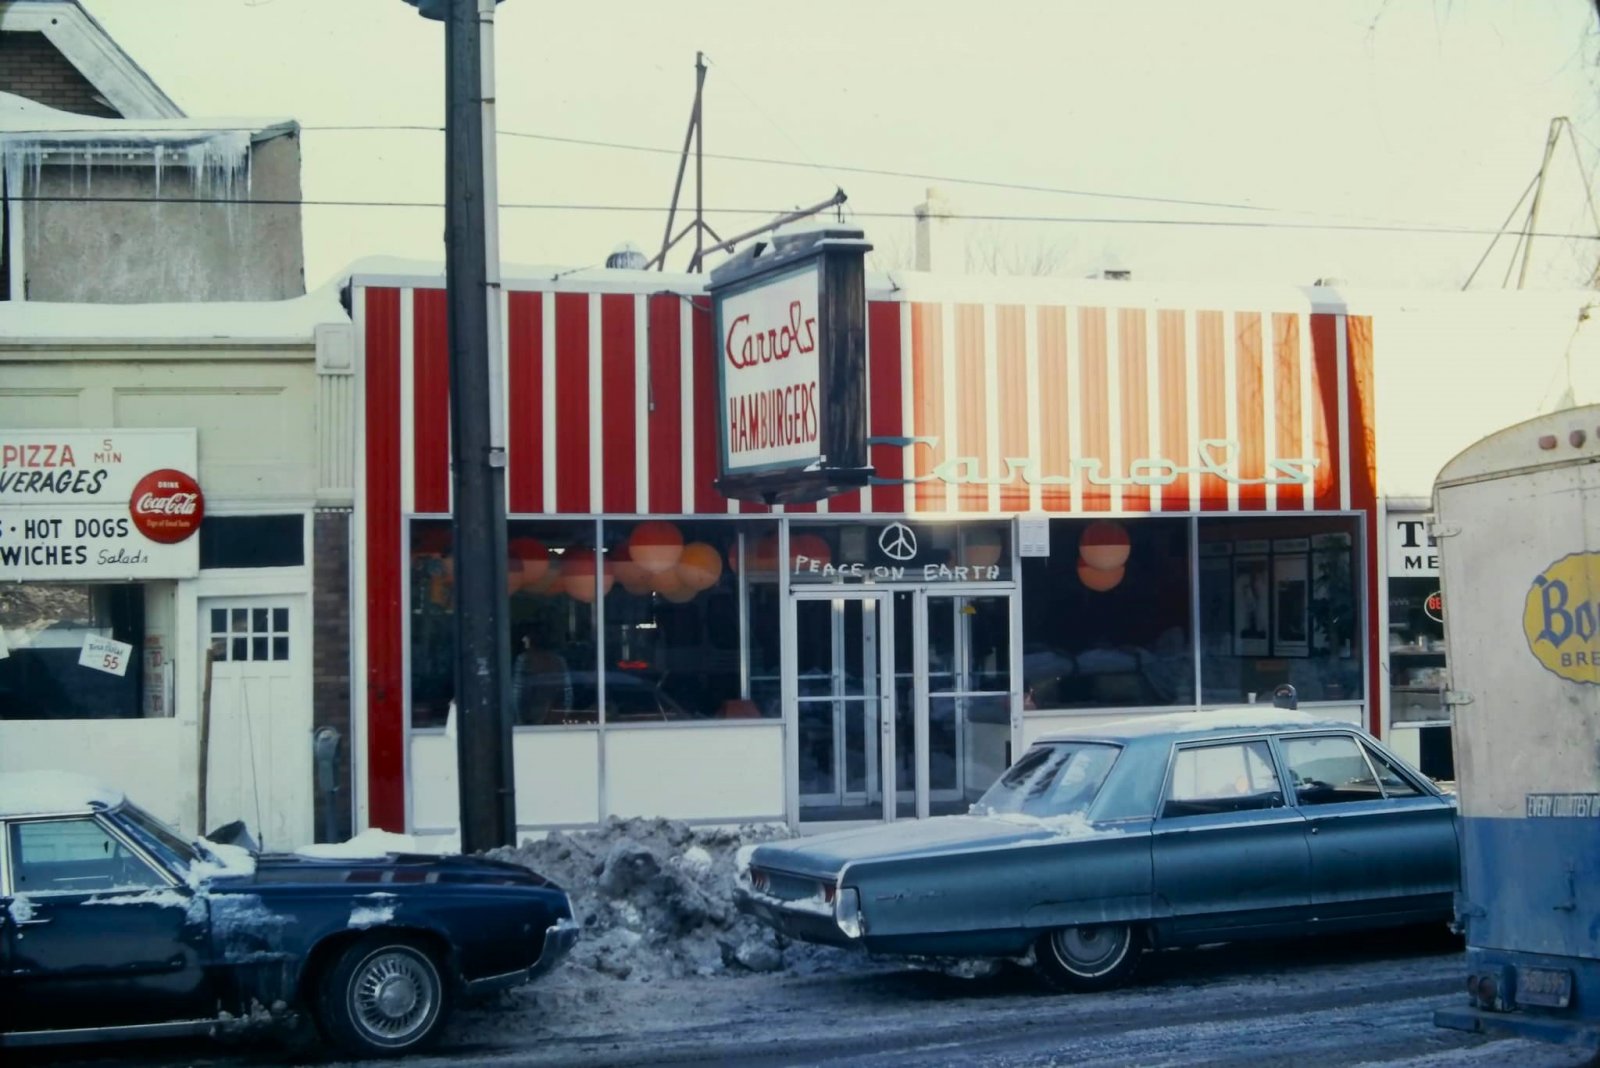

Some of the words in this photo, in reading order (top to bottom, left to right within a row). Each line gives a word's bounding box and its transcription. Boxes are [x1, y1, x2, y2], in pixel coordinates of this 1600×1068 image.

[726, 300, 816, 369] Carrols
[730, 381, 817, 453] HAMBURGERS
[3, 444, 76, 468] PIZZA
[103, 439, 113, 451] 5
[94, 452, 122, 464] MIN
[0, 469, 108, 495] VERAGES
[25, 519, 62, 539] HOT
[75, 518, 129, 538] DOGS
[0, 545, 87, 566] WICHES
[1405, 556, 1440, 569] ME
[795, 554, 865, 578] PEACE
[874, 565, 905, 580] ON
[923, 563, 1000, 581] EARTH
[1532, 574, 1600, 649] Bo
[103, 654, 119, 670] 55
